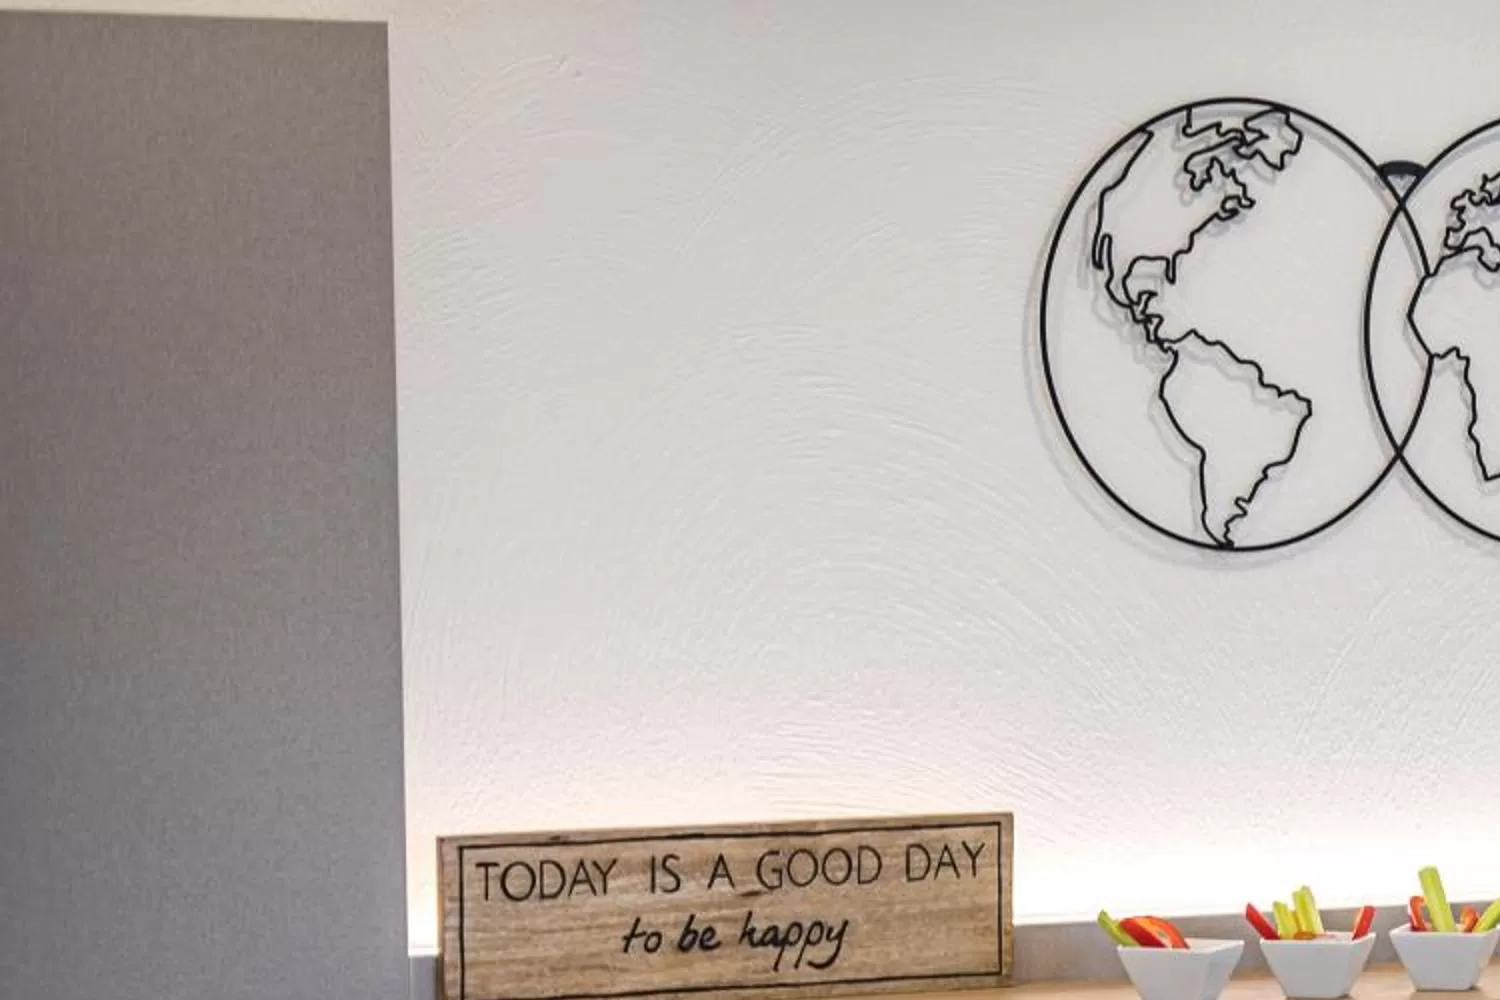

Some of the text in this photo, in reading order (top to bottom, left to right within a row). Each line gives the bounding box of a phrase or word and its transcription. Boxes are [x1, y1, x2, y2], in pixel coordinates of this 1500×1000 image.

[475, 838, 986, 901] TODAY IS A GOOD DAY
[622, 909, 849, 973] to be happy
